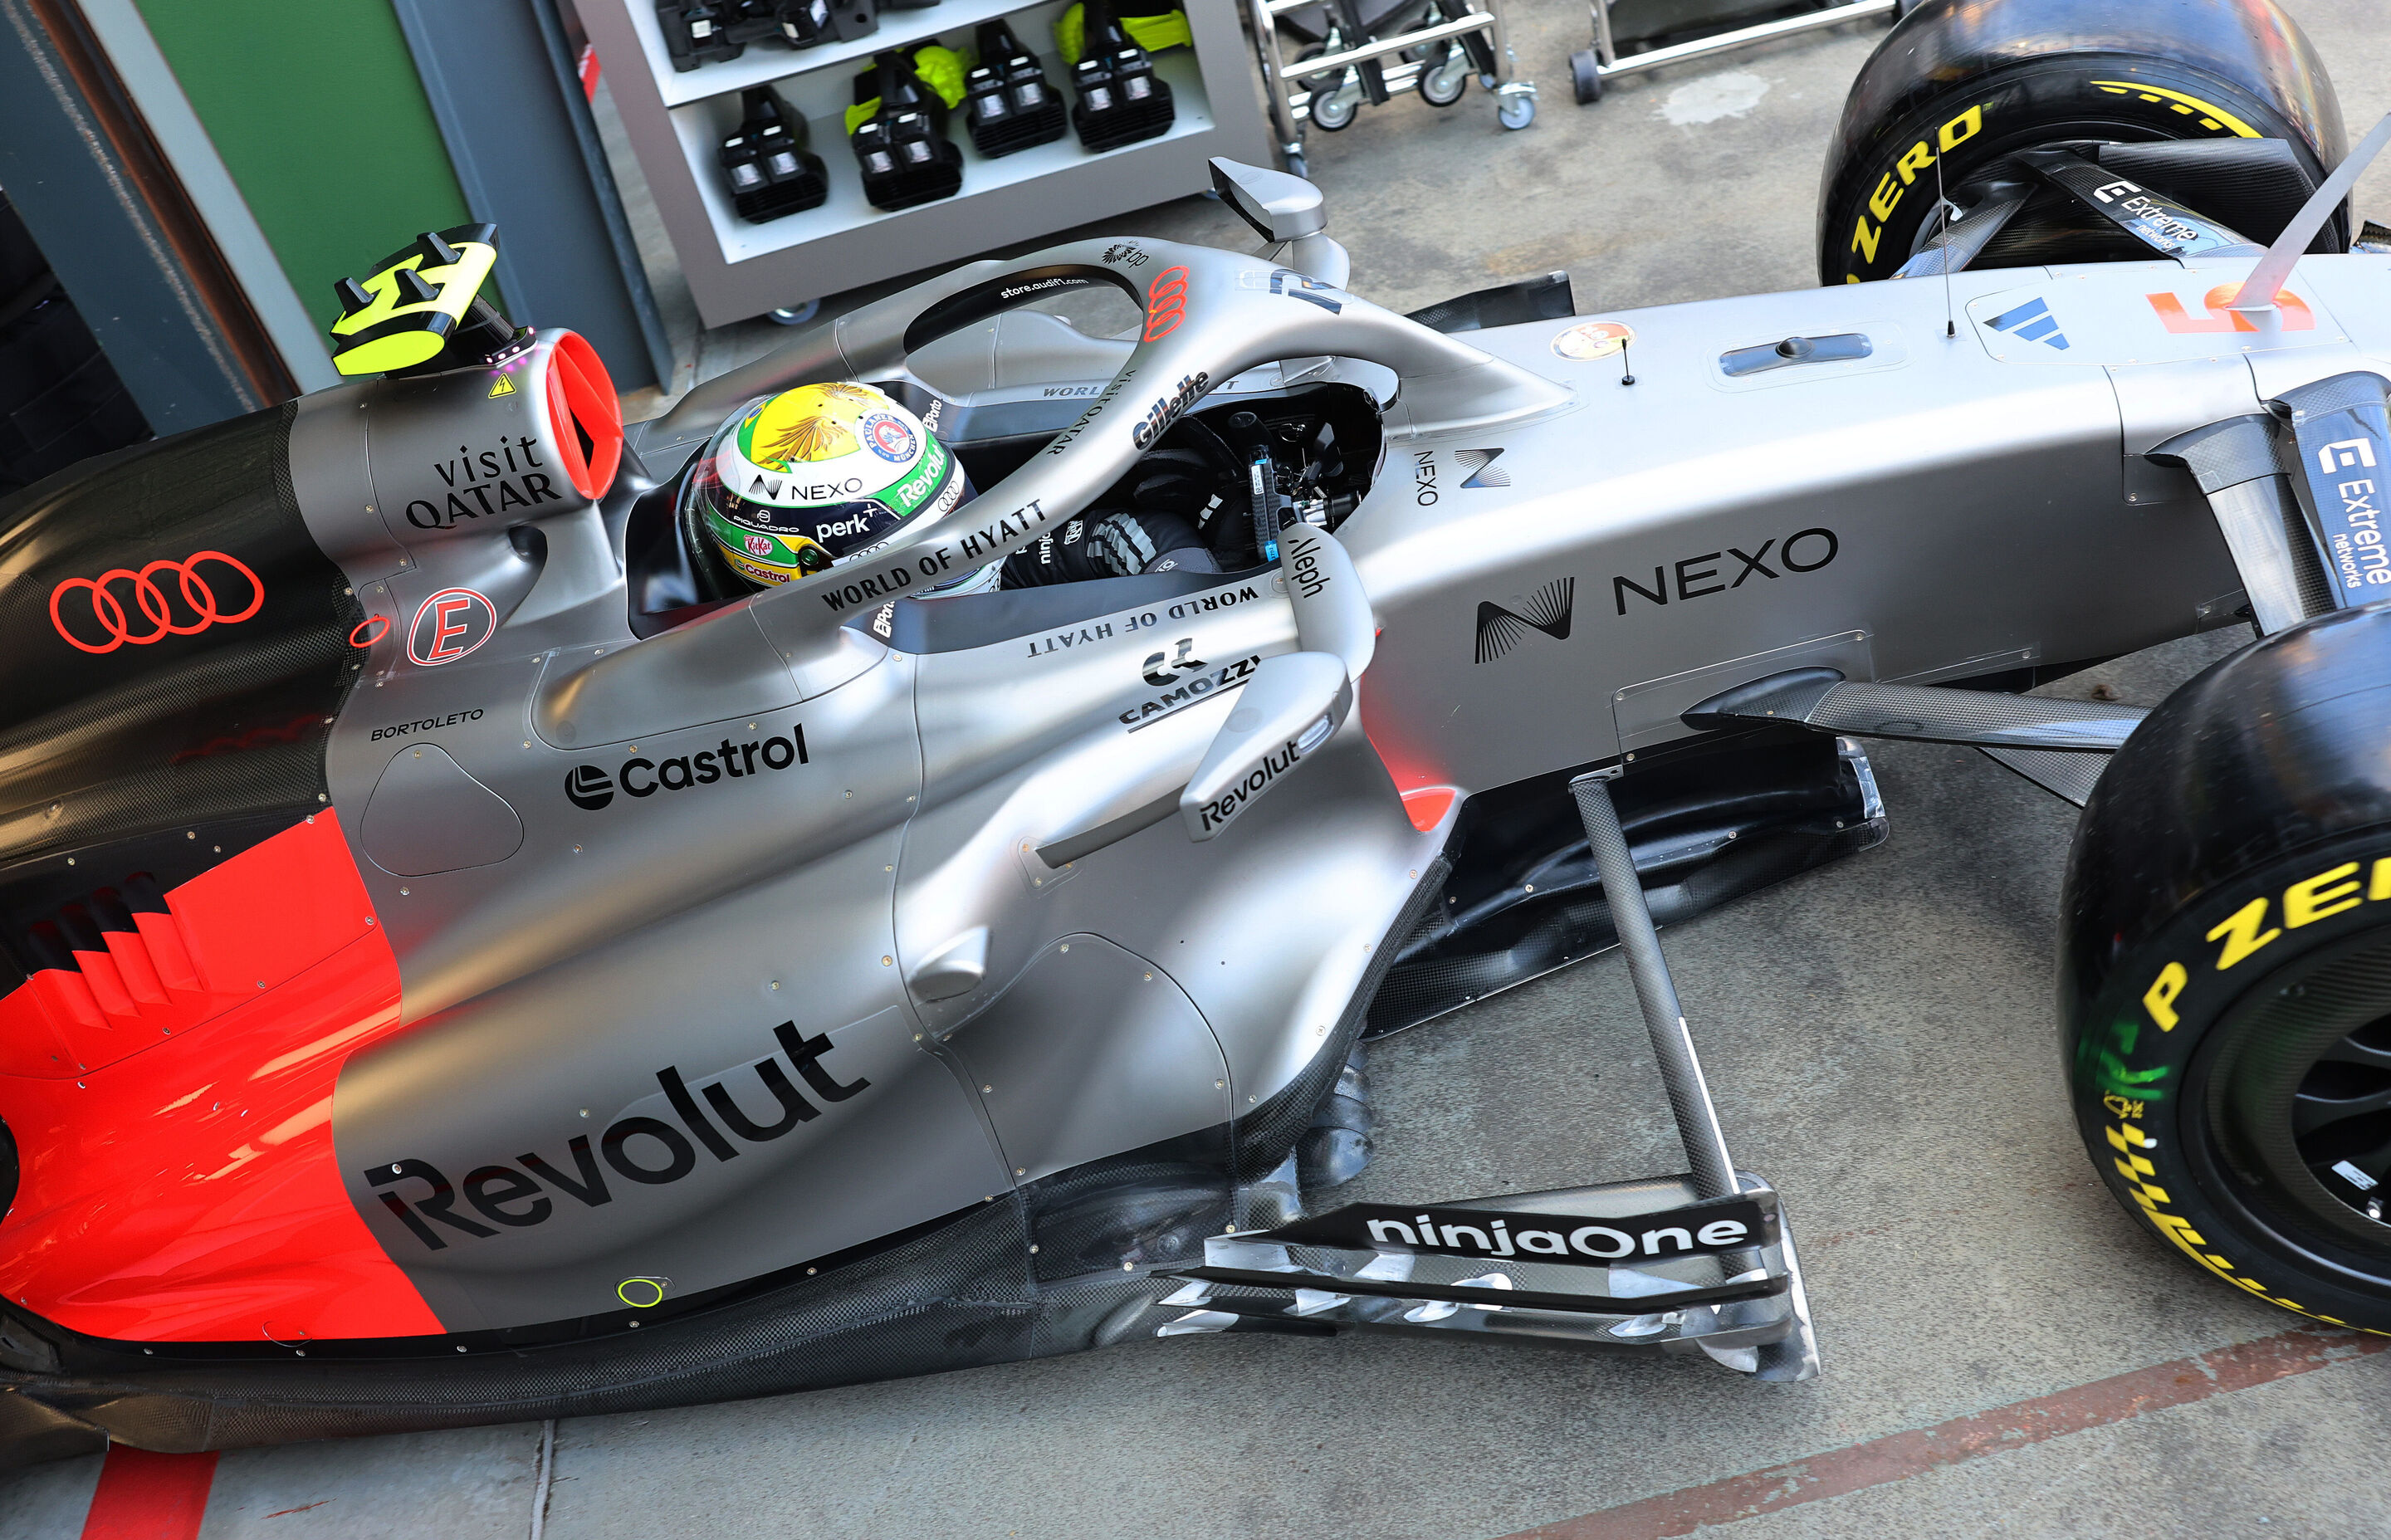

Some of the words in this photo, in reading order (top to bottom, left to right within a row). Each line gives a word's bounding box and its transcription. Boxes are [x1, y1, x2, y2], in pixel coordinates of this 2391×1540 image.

[1851, 105, 1982, 264] ZERO
[2121, 196, 2198, 242] Extreme
[2136, 224, 2176, 249] networks
[1127, 250, 1149, 268] bp
[1000, 278, 1089, 299] store.audif1.com
[2146, 281, 2315, 334] 5
[1044, 386, 1100, 397] WORL
[1098, 369, 1136, 404] visit
[1132, 371, 1210, 451] Gillette
[864, 413, 895, 449] PAULANER
[1046, 406, 1103, 455] QATAR
[434, 436, 544, 484] visit
[897, 443, 945, 507] Revolut
[1413, 450, 1439, 507] NEXO
[405, 473, 562, 530] QATAR
[792, 478, 863, 501] NEXO
[733, 515, 799, 533] PIQUADRO
[747, 537, 772, 555] KitKat
[2338, 478, 2391, 585] Extreme
[745, 564, 790, 583] Castrol
[822, 567, 912, 612] WORLD
[918, 547, 951, 576] OF
[961, 499, 1046, 560] HYATT
[1288, 537, 1331, 599] Aleph
[1613, 527, 1840, 616] NEXO
[2332, 532, 2363, 589] networks
[1125, 613, 1157, 633] OF
[1169, 586, 1259, 620] WORLD
[427, 596, 471, 662] E
[1028, 623, 1113, 658] HYATT
[1118, 654, 1261, 725] CAMOZZI
[369, 708, 484, 741] BORTOLETO
[619, 722, 809, 799] Castrol
[1200, 741, 1300, 831] Revolut
[2143, 961, 2188, 1032] P
[2205, 856, 2391, 970] ZE
[363, 1019, 872, 1251] Revolut
[1366, 1215, 1749, 1259] ninjaOne
